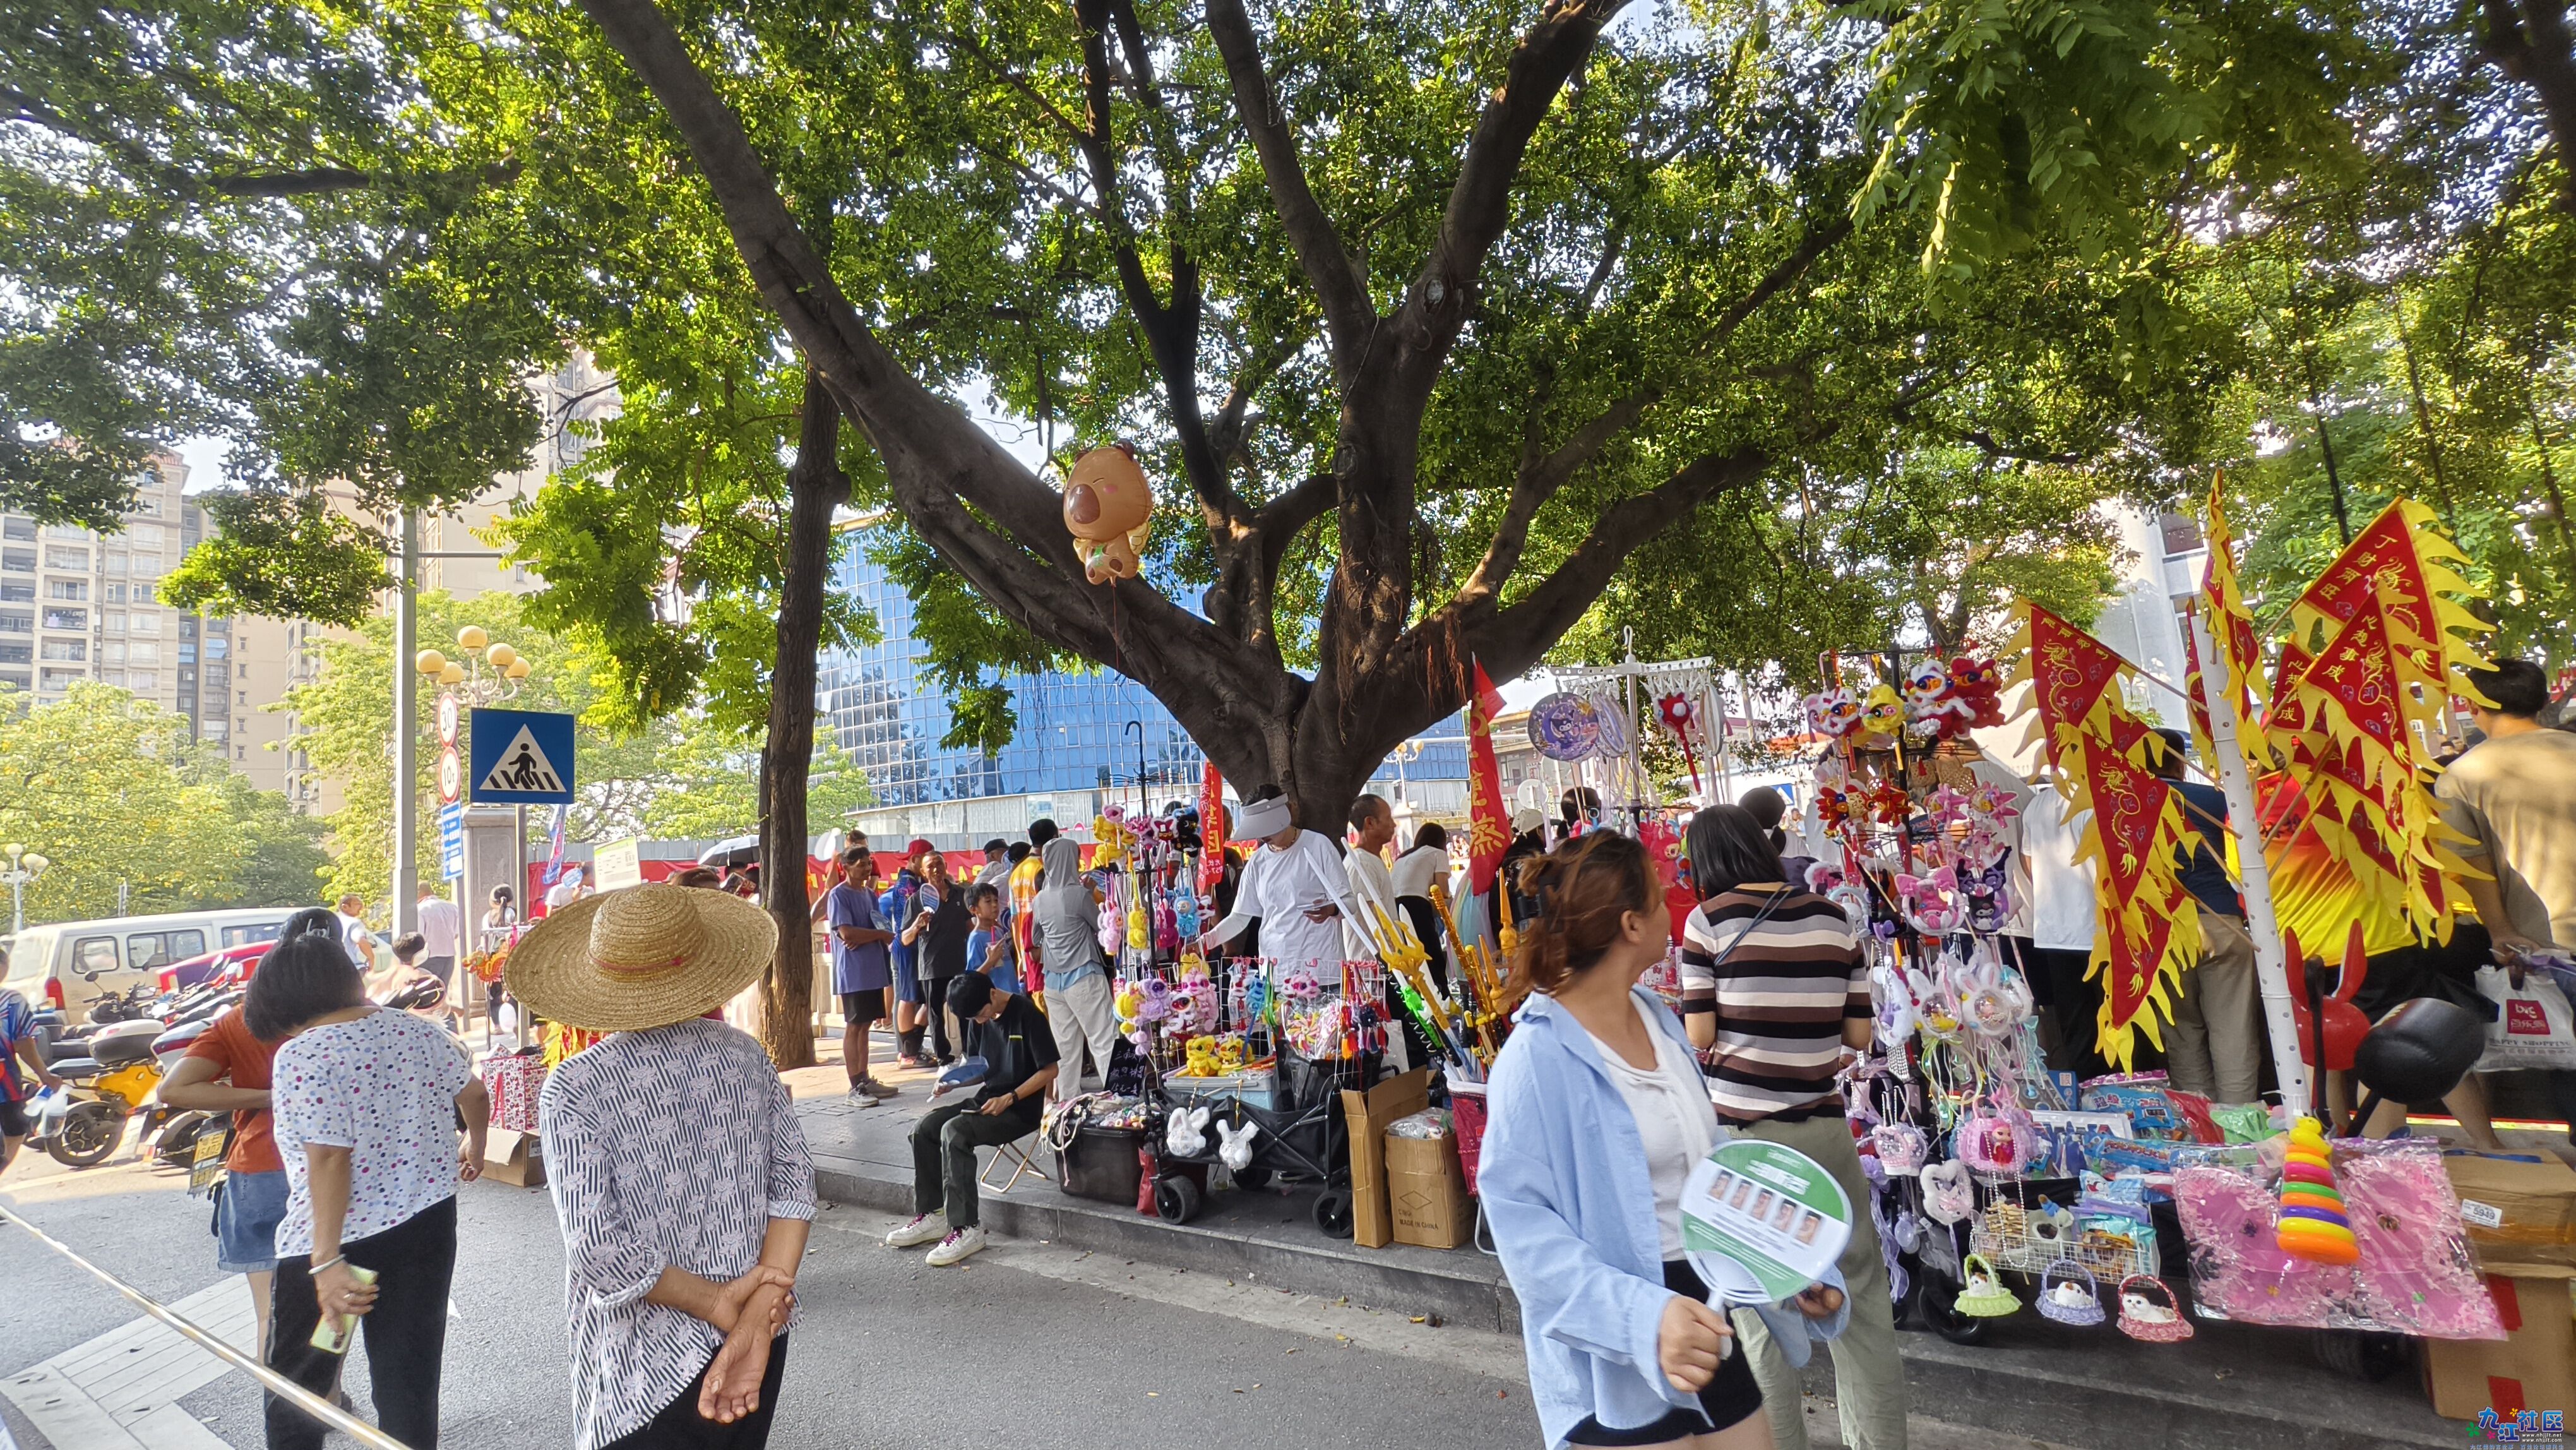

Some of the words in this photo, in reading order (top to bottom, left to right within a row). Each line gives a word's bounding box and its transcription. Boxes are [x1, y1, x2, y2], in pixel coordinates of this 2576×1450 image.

[2322, 614, 2378, 683] 心想事成
[442, 707, 453, 731] 30
[1399, 1218, 1414, 1227] MADE
[1414, 1220, 1421, 1228] IN
[1421, 1221, 1439, 1230] CHINA
